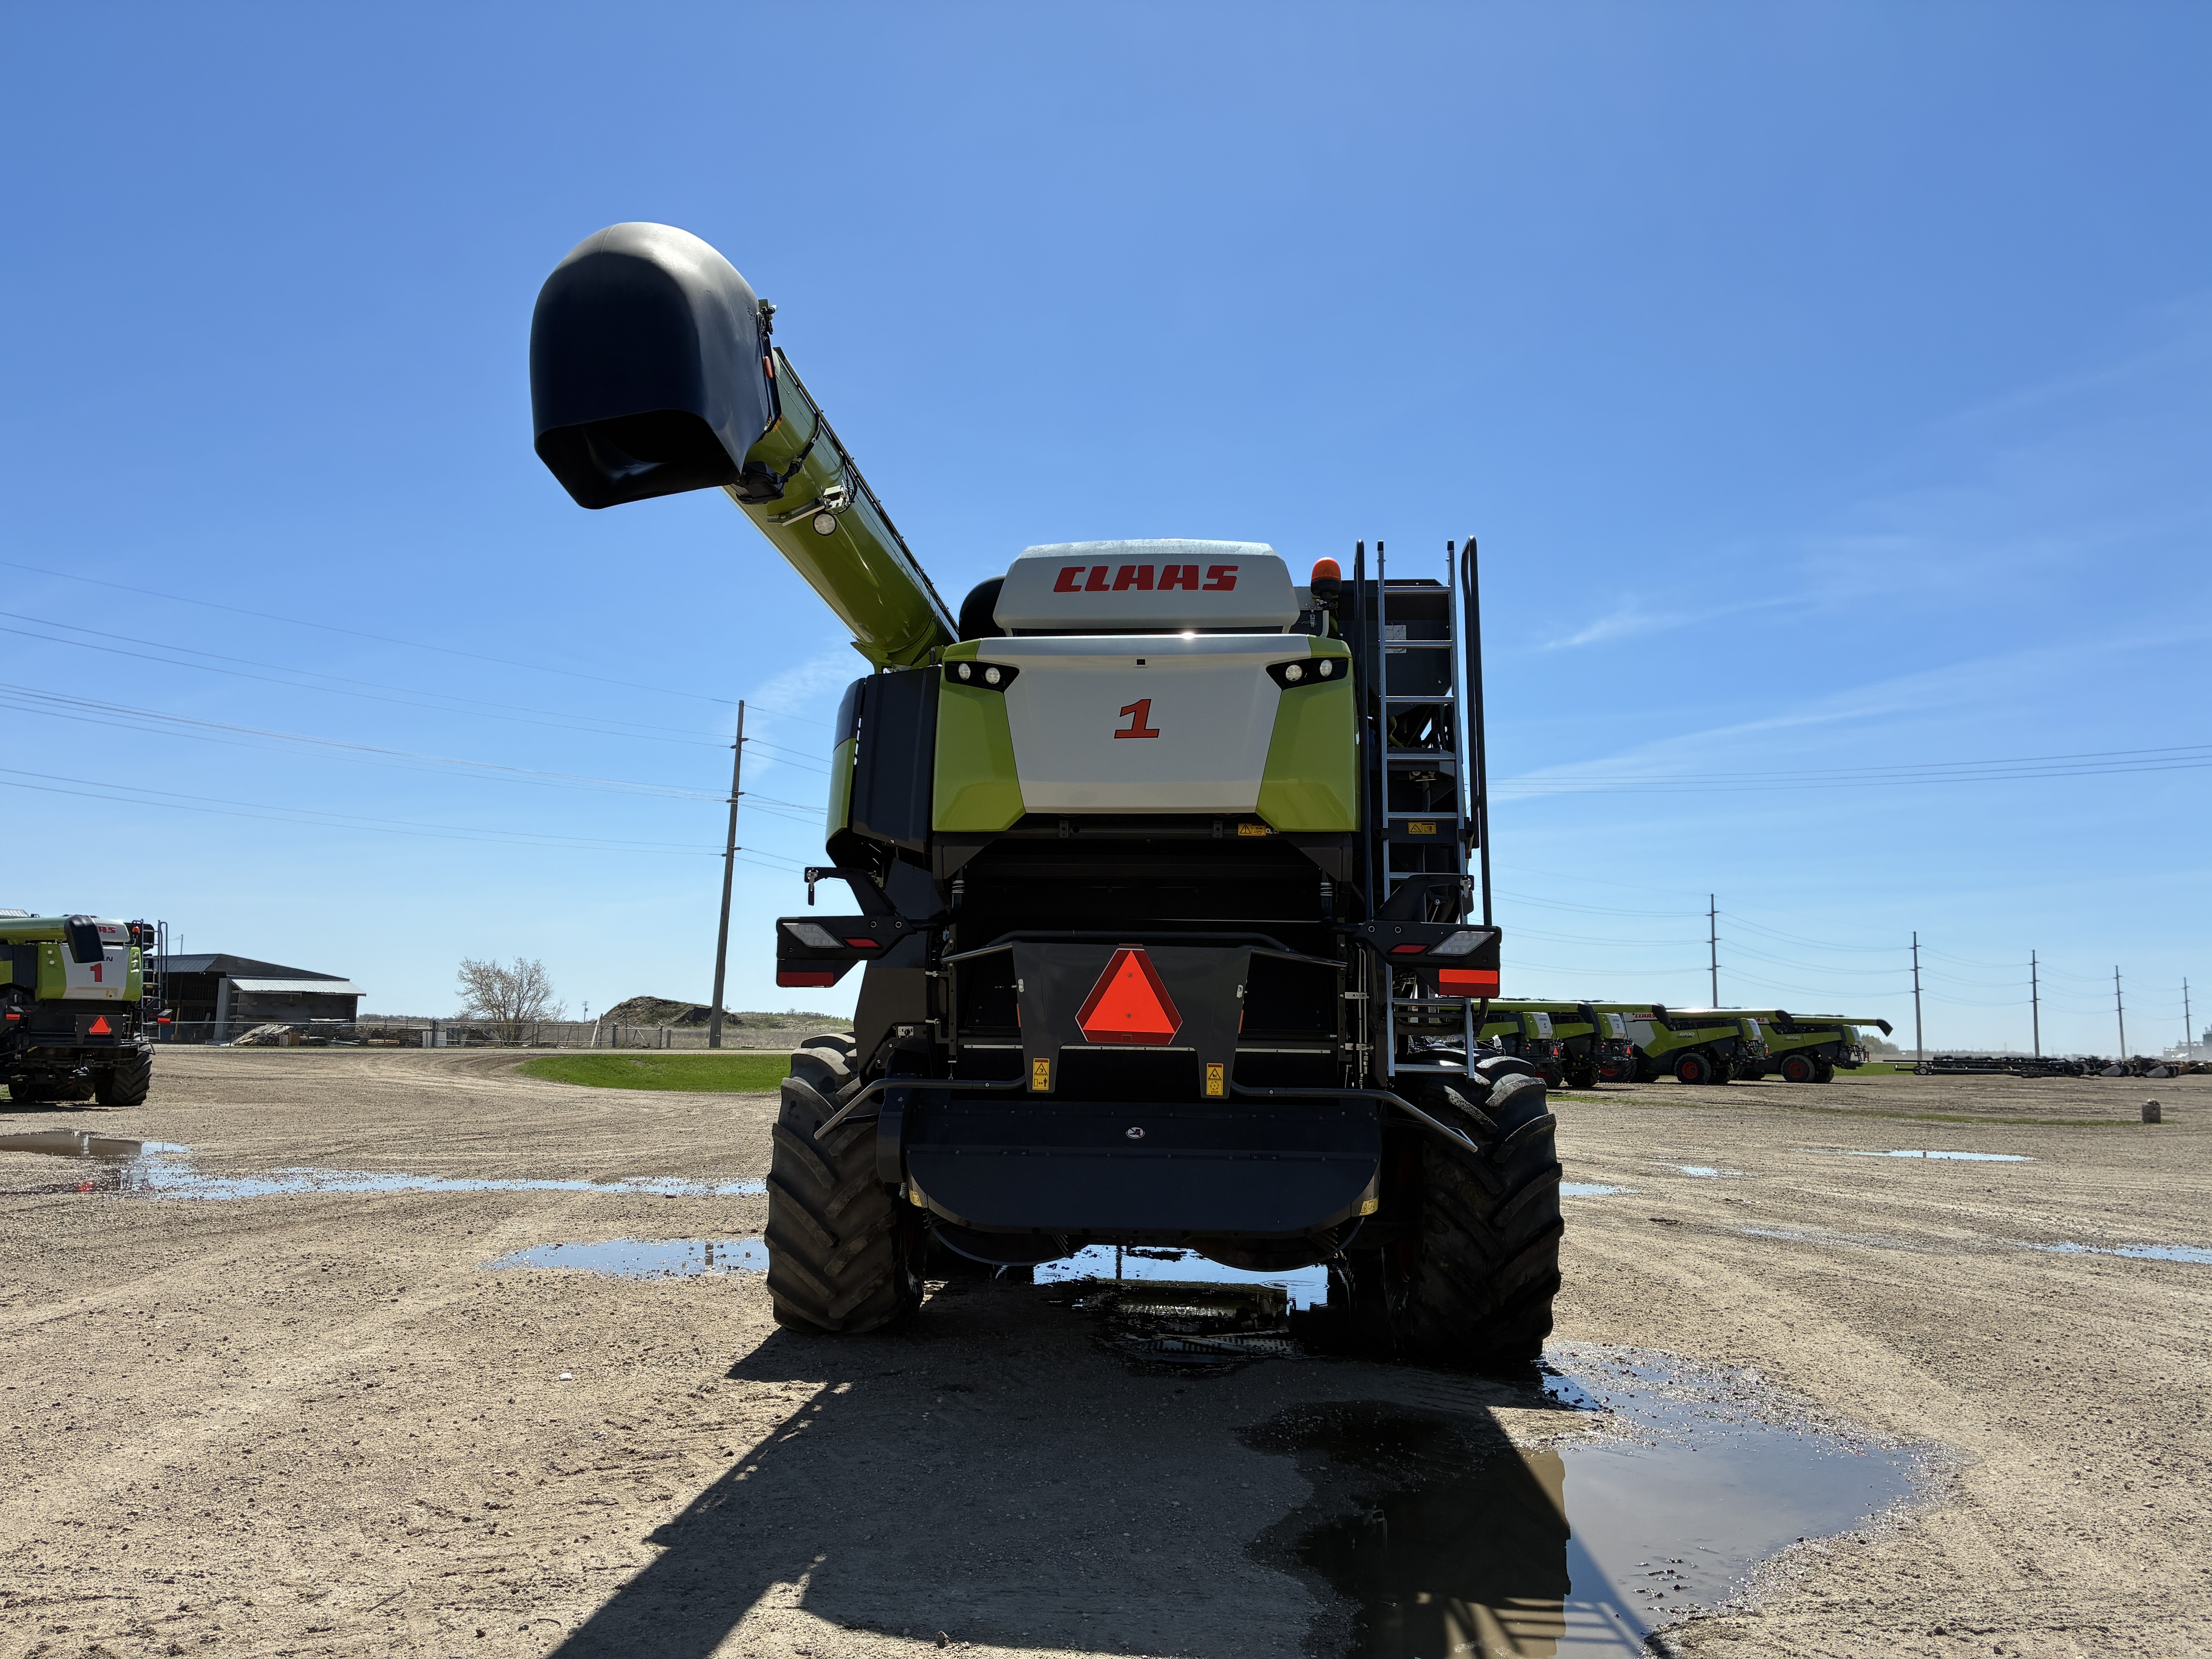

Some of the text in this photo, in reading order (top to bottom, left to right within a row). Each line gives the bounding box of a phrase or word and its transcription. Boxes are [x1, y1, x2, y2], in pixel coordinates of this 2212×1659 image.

[1053, 565, 1239, 592] CLAAS
[1114, 699, 1160, 739] 1
[90, 963, 102, 982] 1
